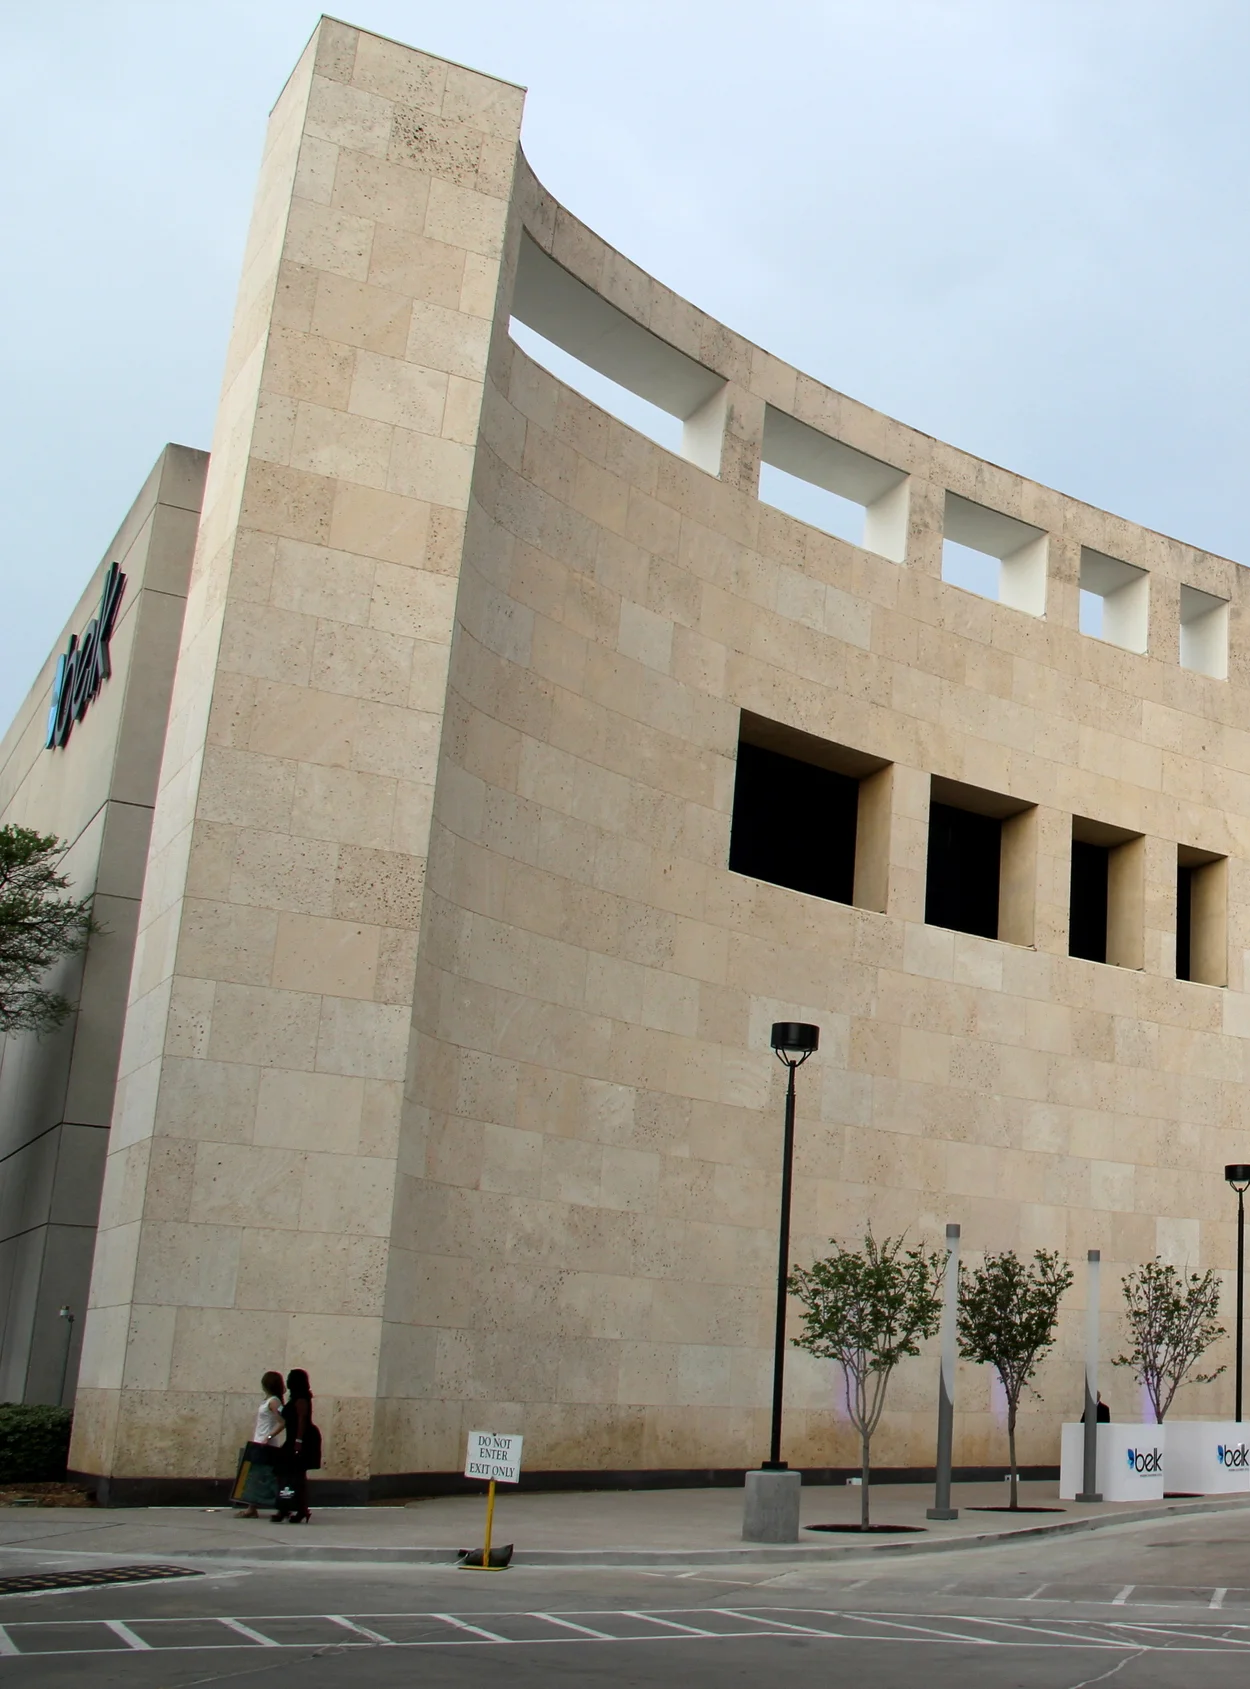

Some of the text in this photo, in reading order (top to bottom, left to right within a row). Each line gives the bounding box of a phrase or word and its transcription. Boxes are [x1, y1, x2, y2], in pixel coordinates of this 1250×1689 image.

[478, 1436, 512, 1449] DO NOT
[480, 1448, 508, 1460] ENTER
[1135, 1448, 1162, 1472] belk
[1224, 1444, 1250, 1467] belk
[470, 1463, 515, 1477] EXIT ONLY
